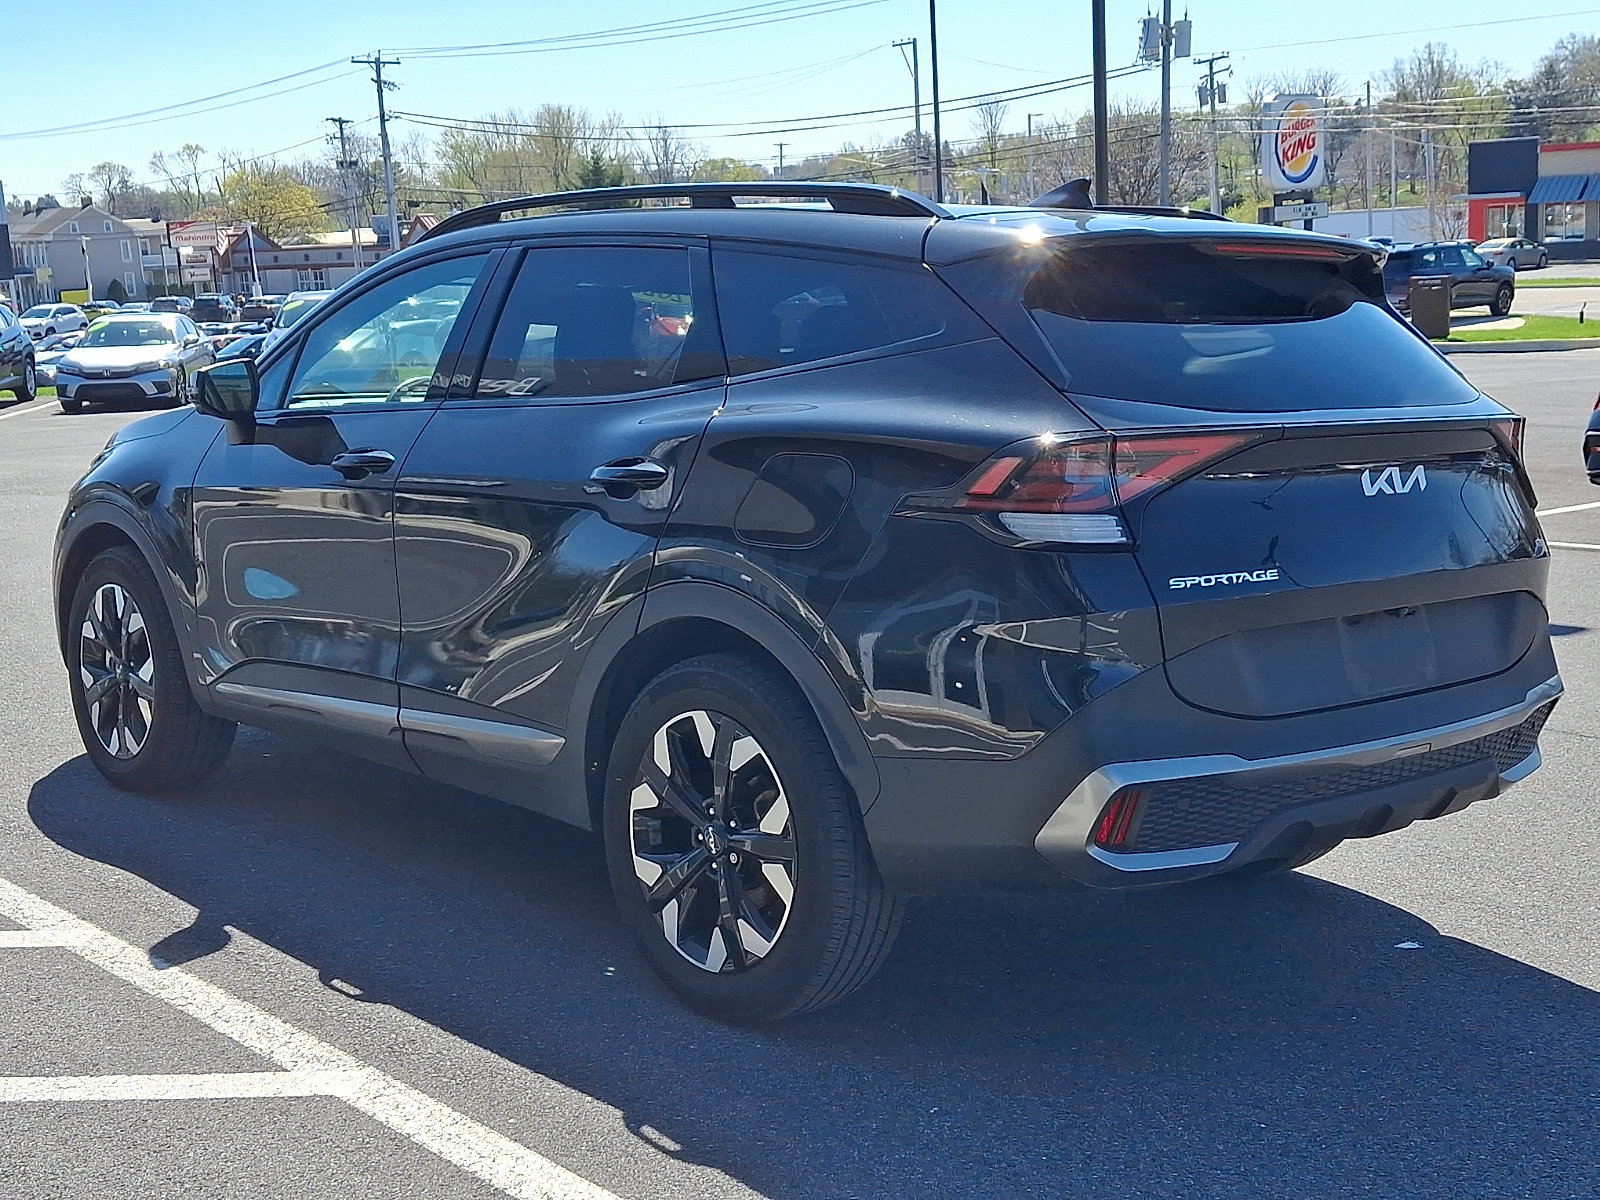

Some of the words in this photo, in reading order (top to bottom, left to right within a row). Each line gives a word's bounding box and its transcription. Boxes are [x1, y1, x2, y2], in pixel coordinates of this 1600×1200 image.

[1281, 113, 1316, 144] BURGER
[1282, 131, 1316, 168] KING
[1361, 465, 1427, 496] KIA
[1169, 569, 1280, 589] SPORTAGE
